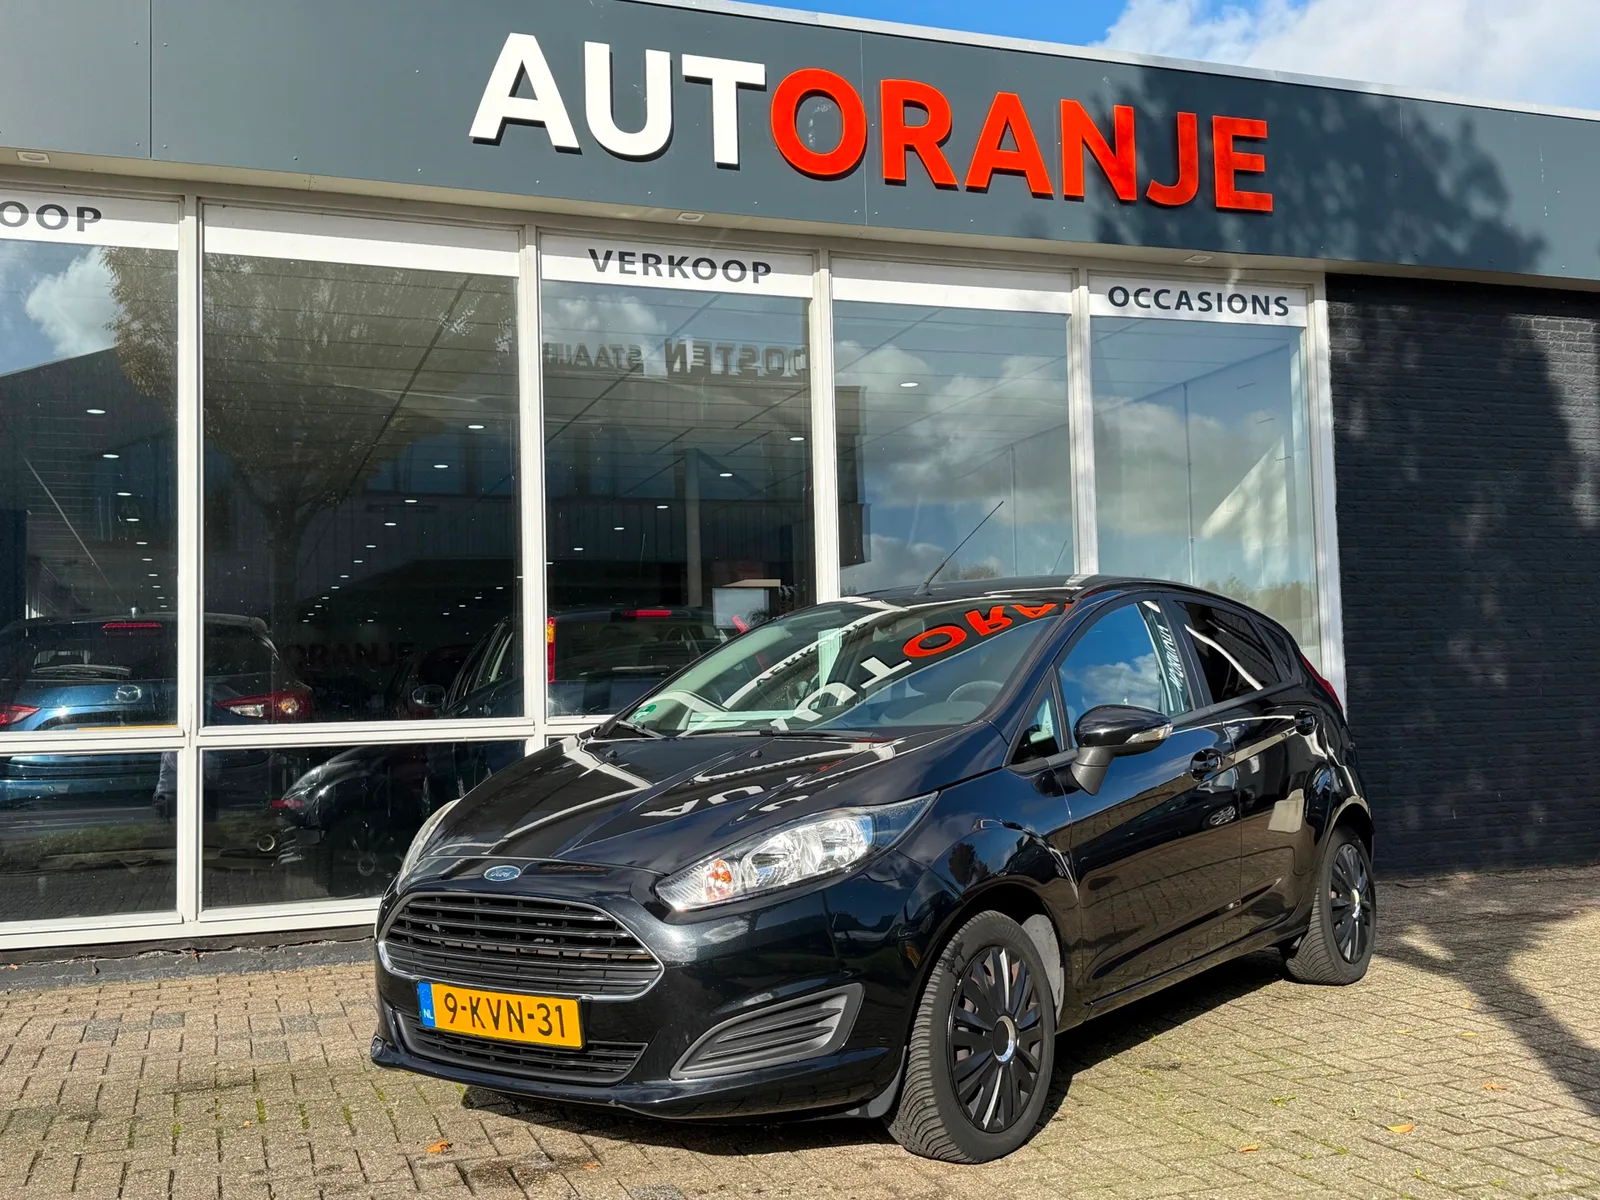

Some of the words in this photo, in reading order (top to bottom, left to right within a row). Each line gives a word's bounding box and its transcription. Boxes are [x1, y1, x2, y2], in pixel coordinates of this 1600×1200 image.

[468, 32, 1274, 213] AUTORANJE
[588, 248, 772, 284] VERKOOP
[1108, 286, 1289, 317] OCCASIONS
[423, 1008, 434, 1020] NL
[444, 992, 566, 1038] 9-KVN-31
